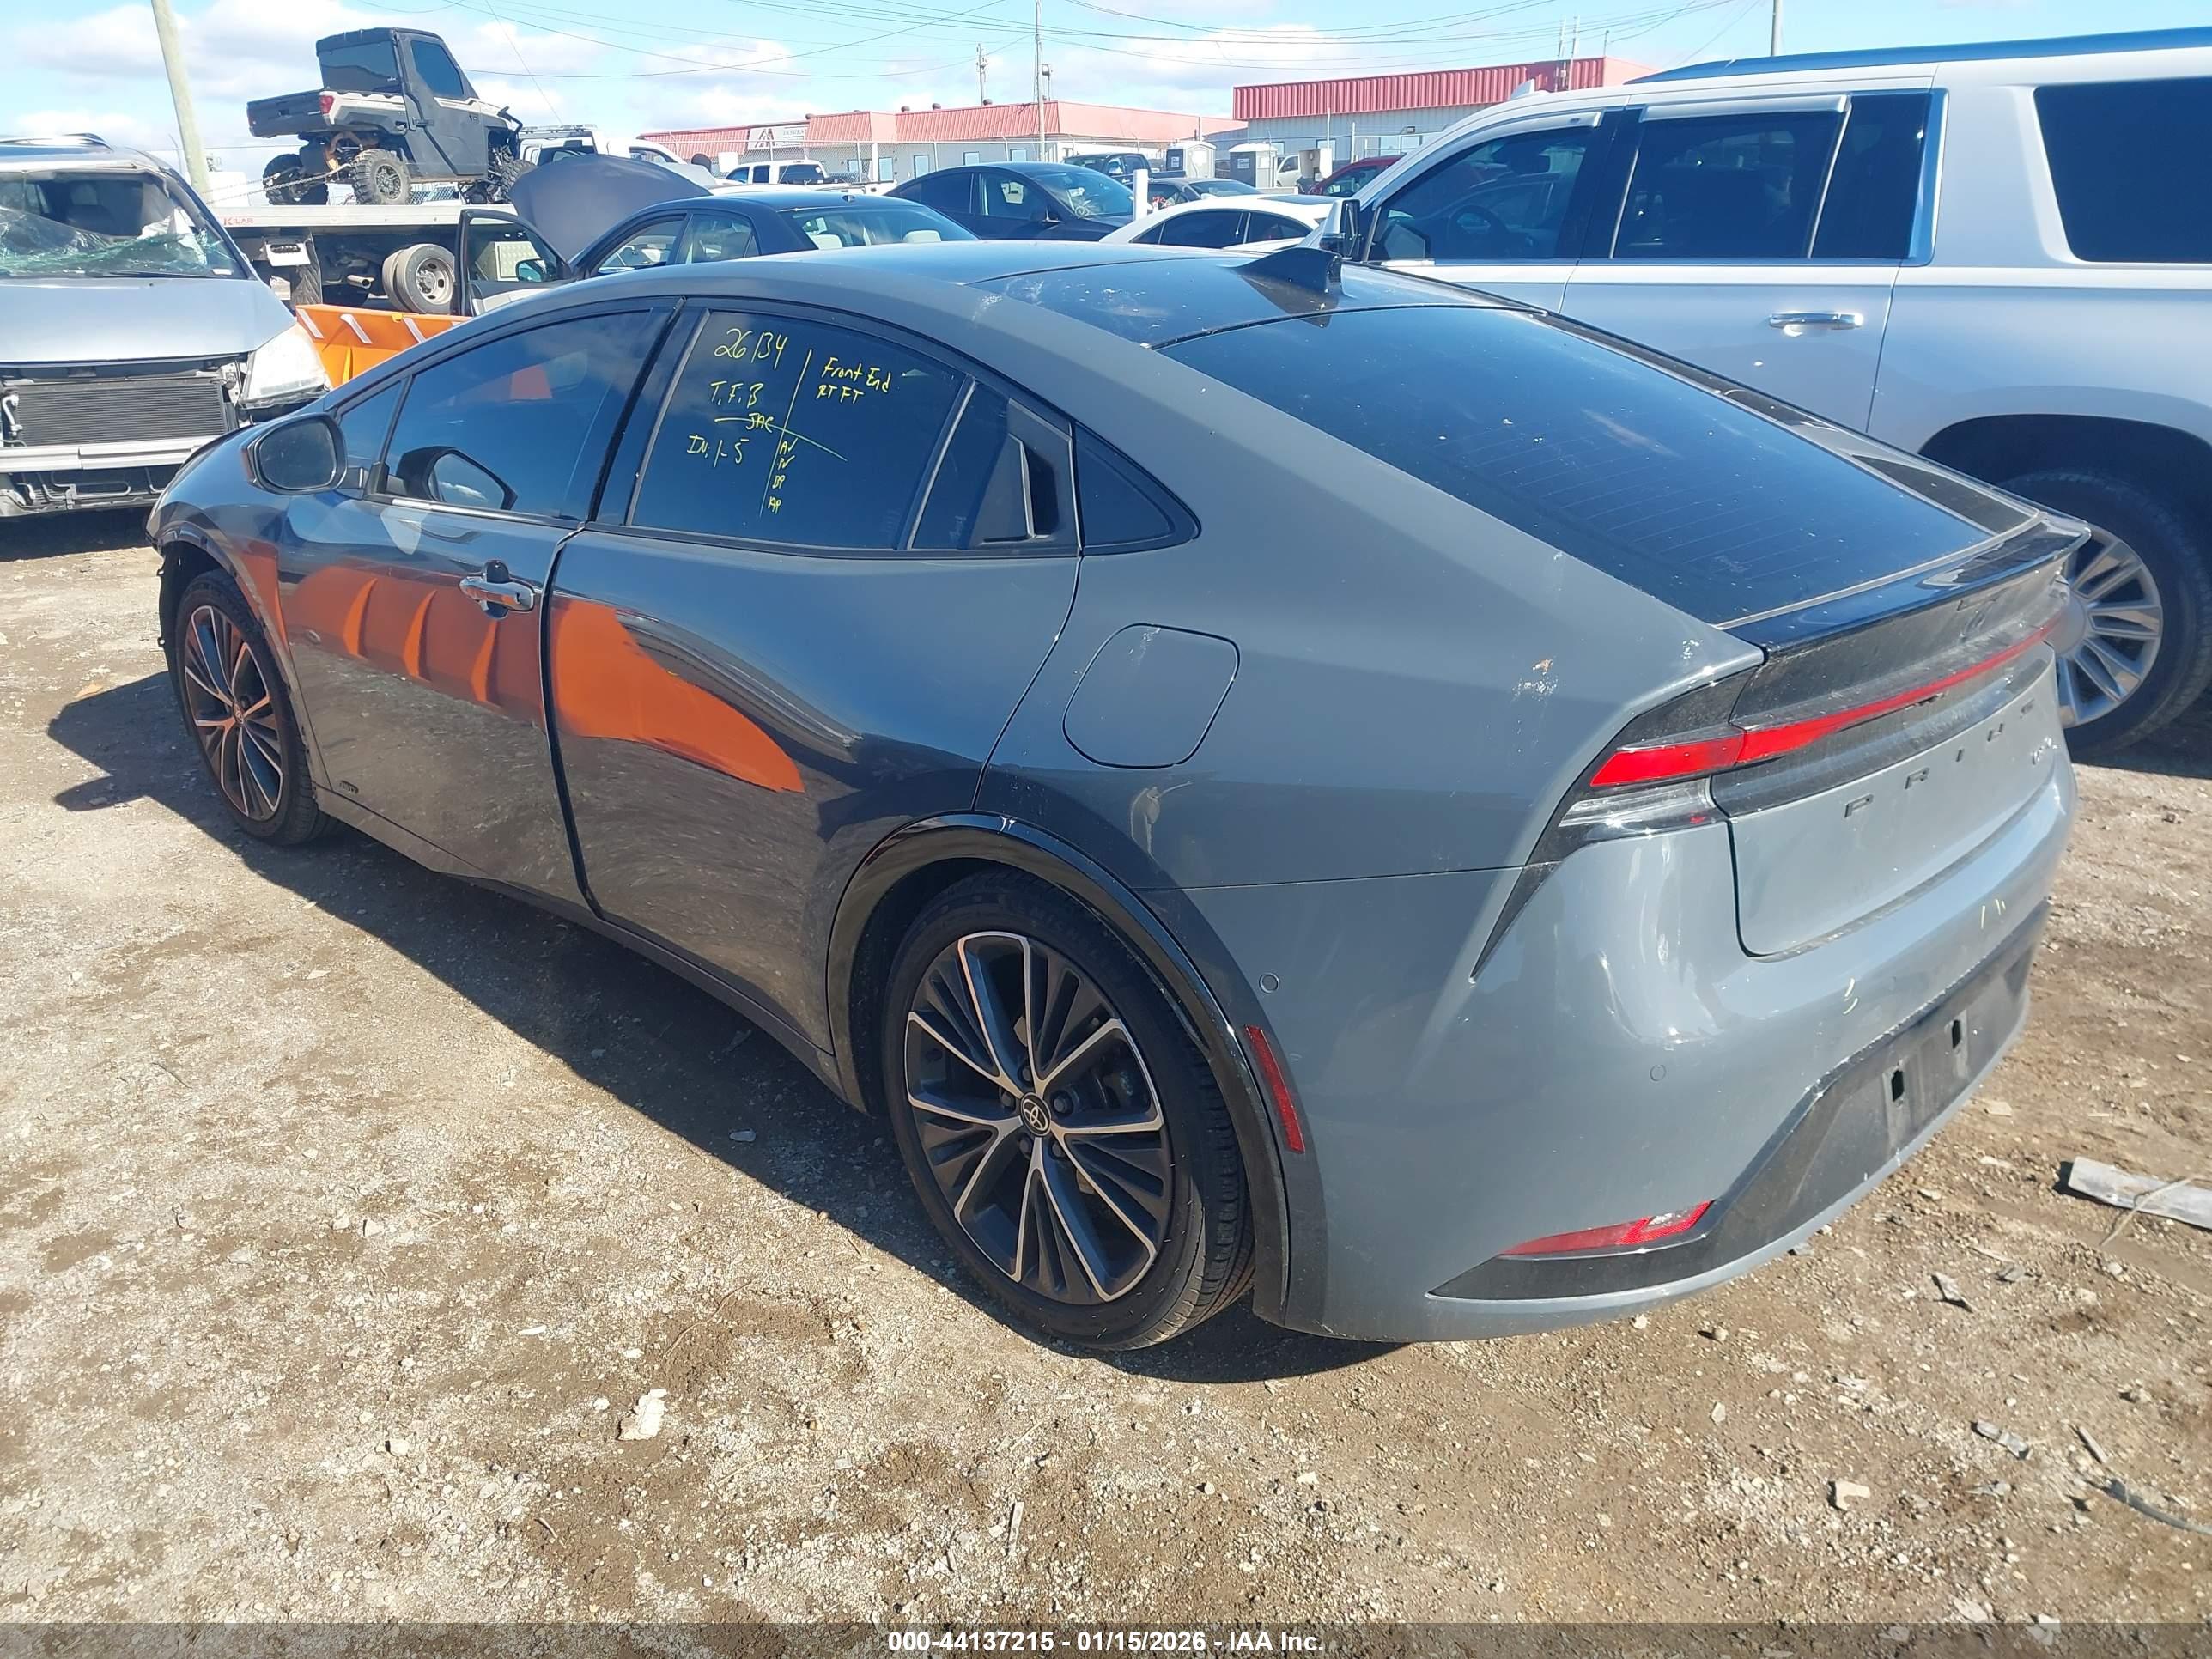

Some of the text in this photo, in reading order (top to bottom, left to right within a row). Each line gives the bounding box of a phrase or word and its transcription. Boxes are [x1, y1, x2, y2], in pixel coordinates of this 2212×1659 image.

[821, 356, 891, 392] Front End
[839, 386, 865, 404] FT
